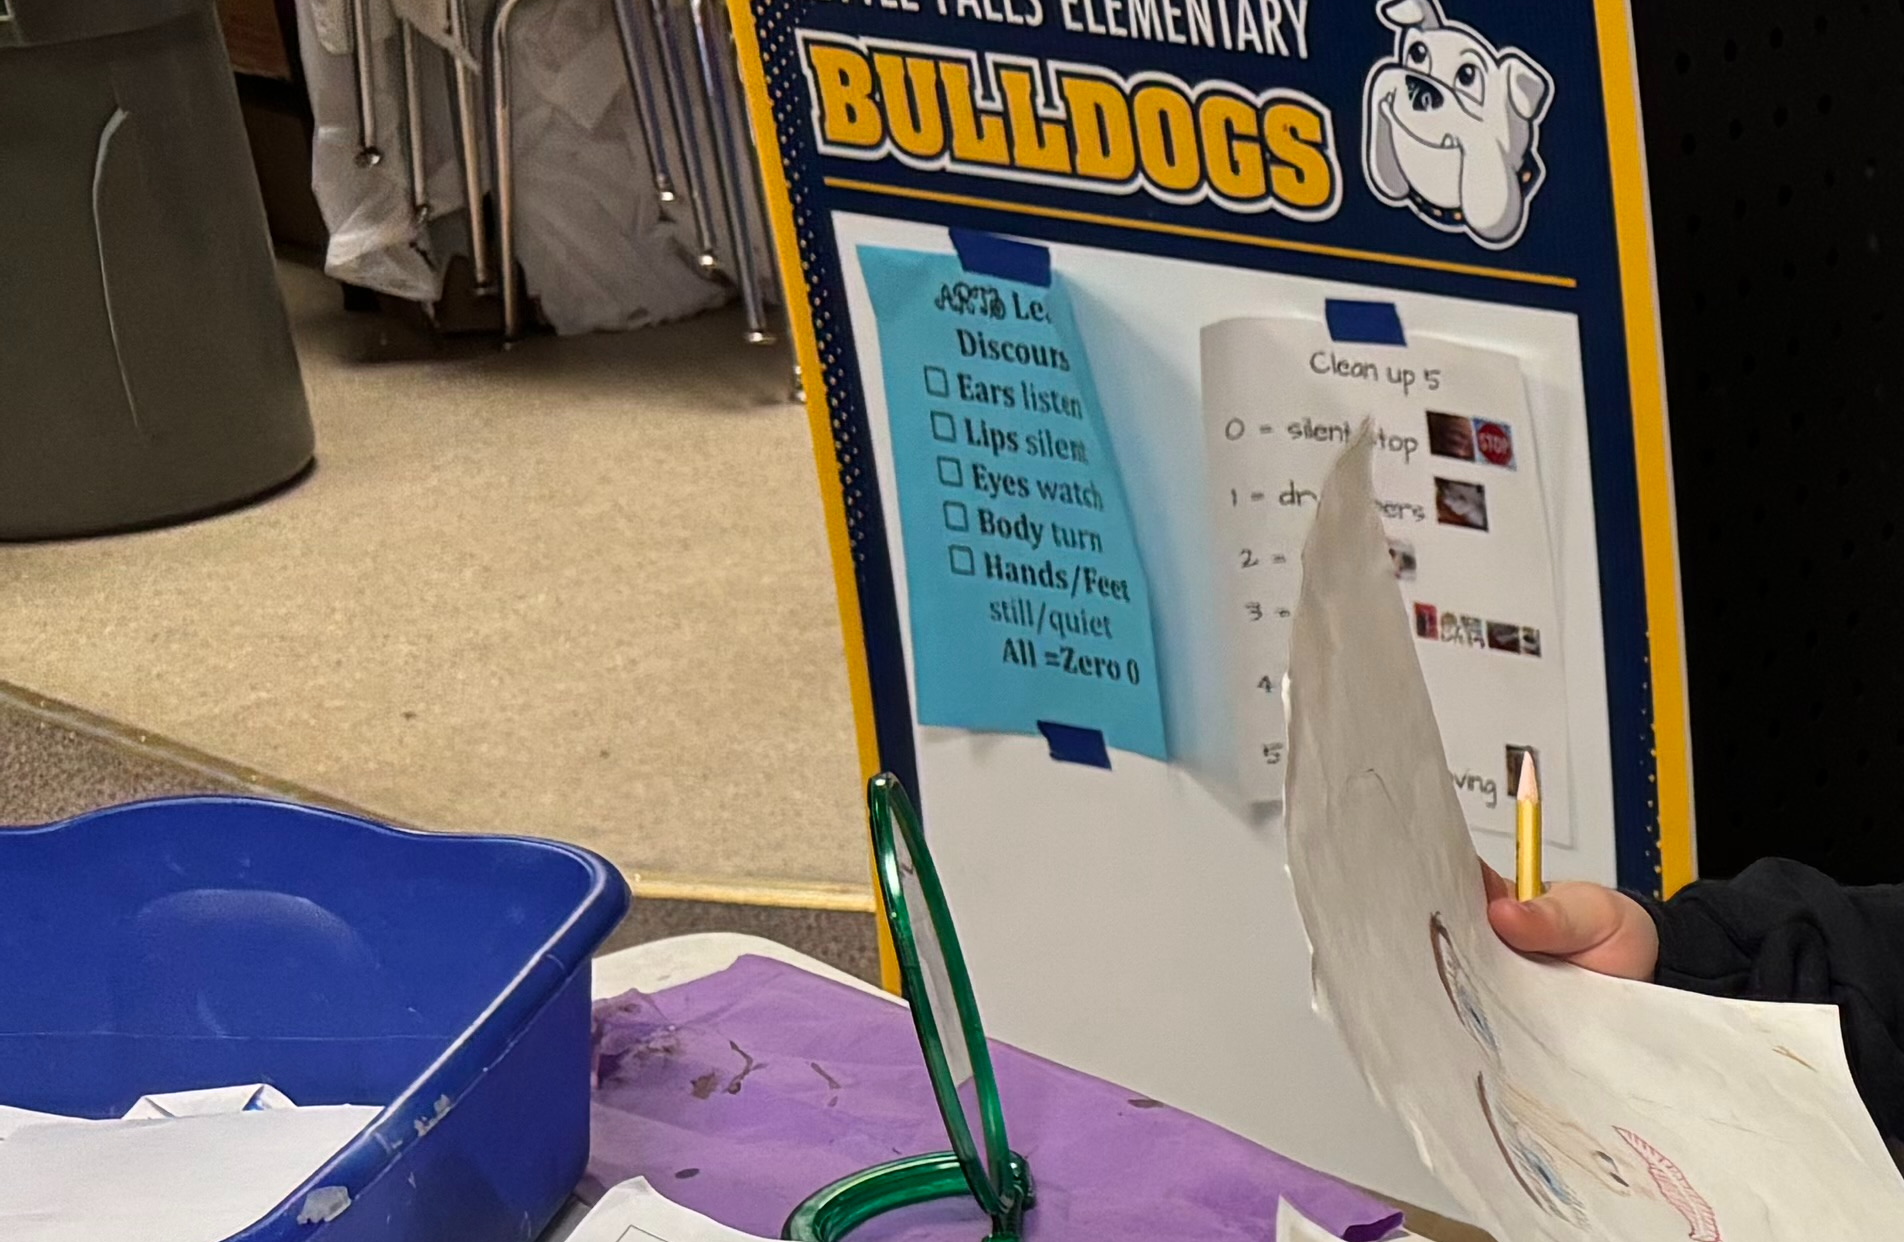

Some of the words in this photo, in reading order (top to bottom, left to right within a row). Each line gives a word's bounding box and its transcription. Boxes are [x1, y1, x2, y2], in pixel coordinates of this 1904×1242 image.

[799, 35, 1339, 215] BULLDOGS
[1012, 290, 1051, 324] Le
[956, 372, 1016, 408] Ears
[1020, 380, 1083, 420] listen
[1309, 352, 1379, 381] Clean
[1387, 366, 1415, 397] up
[1423, 369, 1442, 391] 5
[964, 416, 1019, 457] Lips
[1287, 417, 1352, 443] silent
[1374, 427, 1419, 464] top
[972, 463, 1030, 498] Eyes
[1037, 479, 1104, 511] watch
[977, 507, 1044, 551] Body
[1051, 521, 1104, 552] turn
[984, 551, 1131, 603] Hands/Feet
[1239, 549, 1259, 569] 2
[989, 595, 1113, 639] still/quiet
[1245, 602, 1263, 621] 3
[1003, 637, 1037, 668] All
[1127, 659, 1140, 685] 0
[1257, 675, 1273, 693] 4
[1263, 742, 1283, 765] 5
